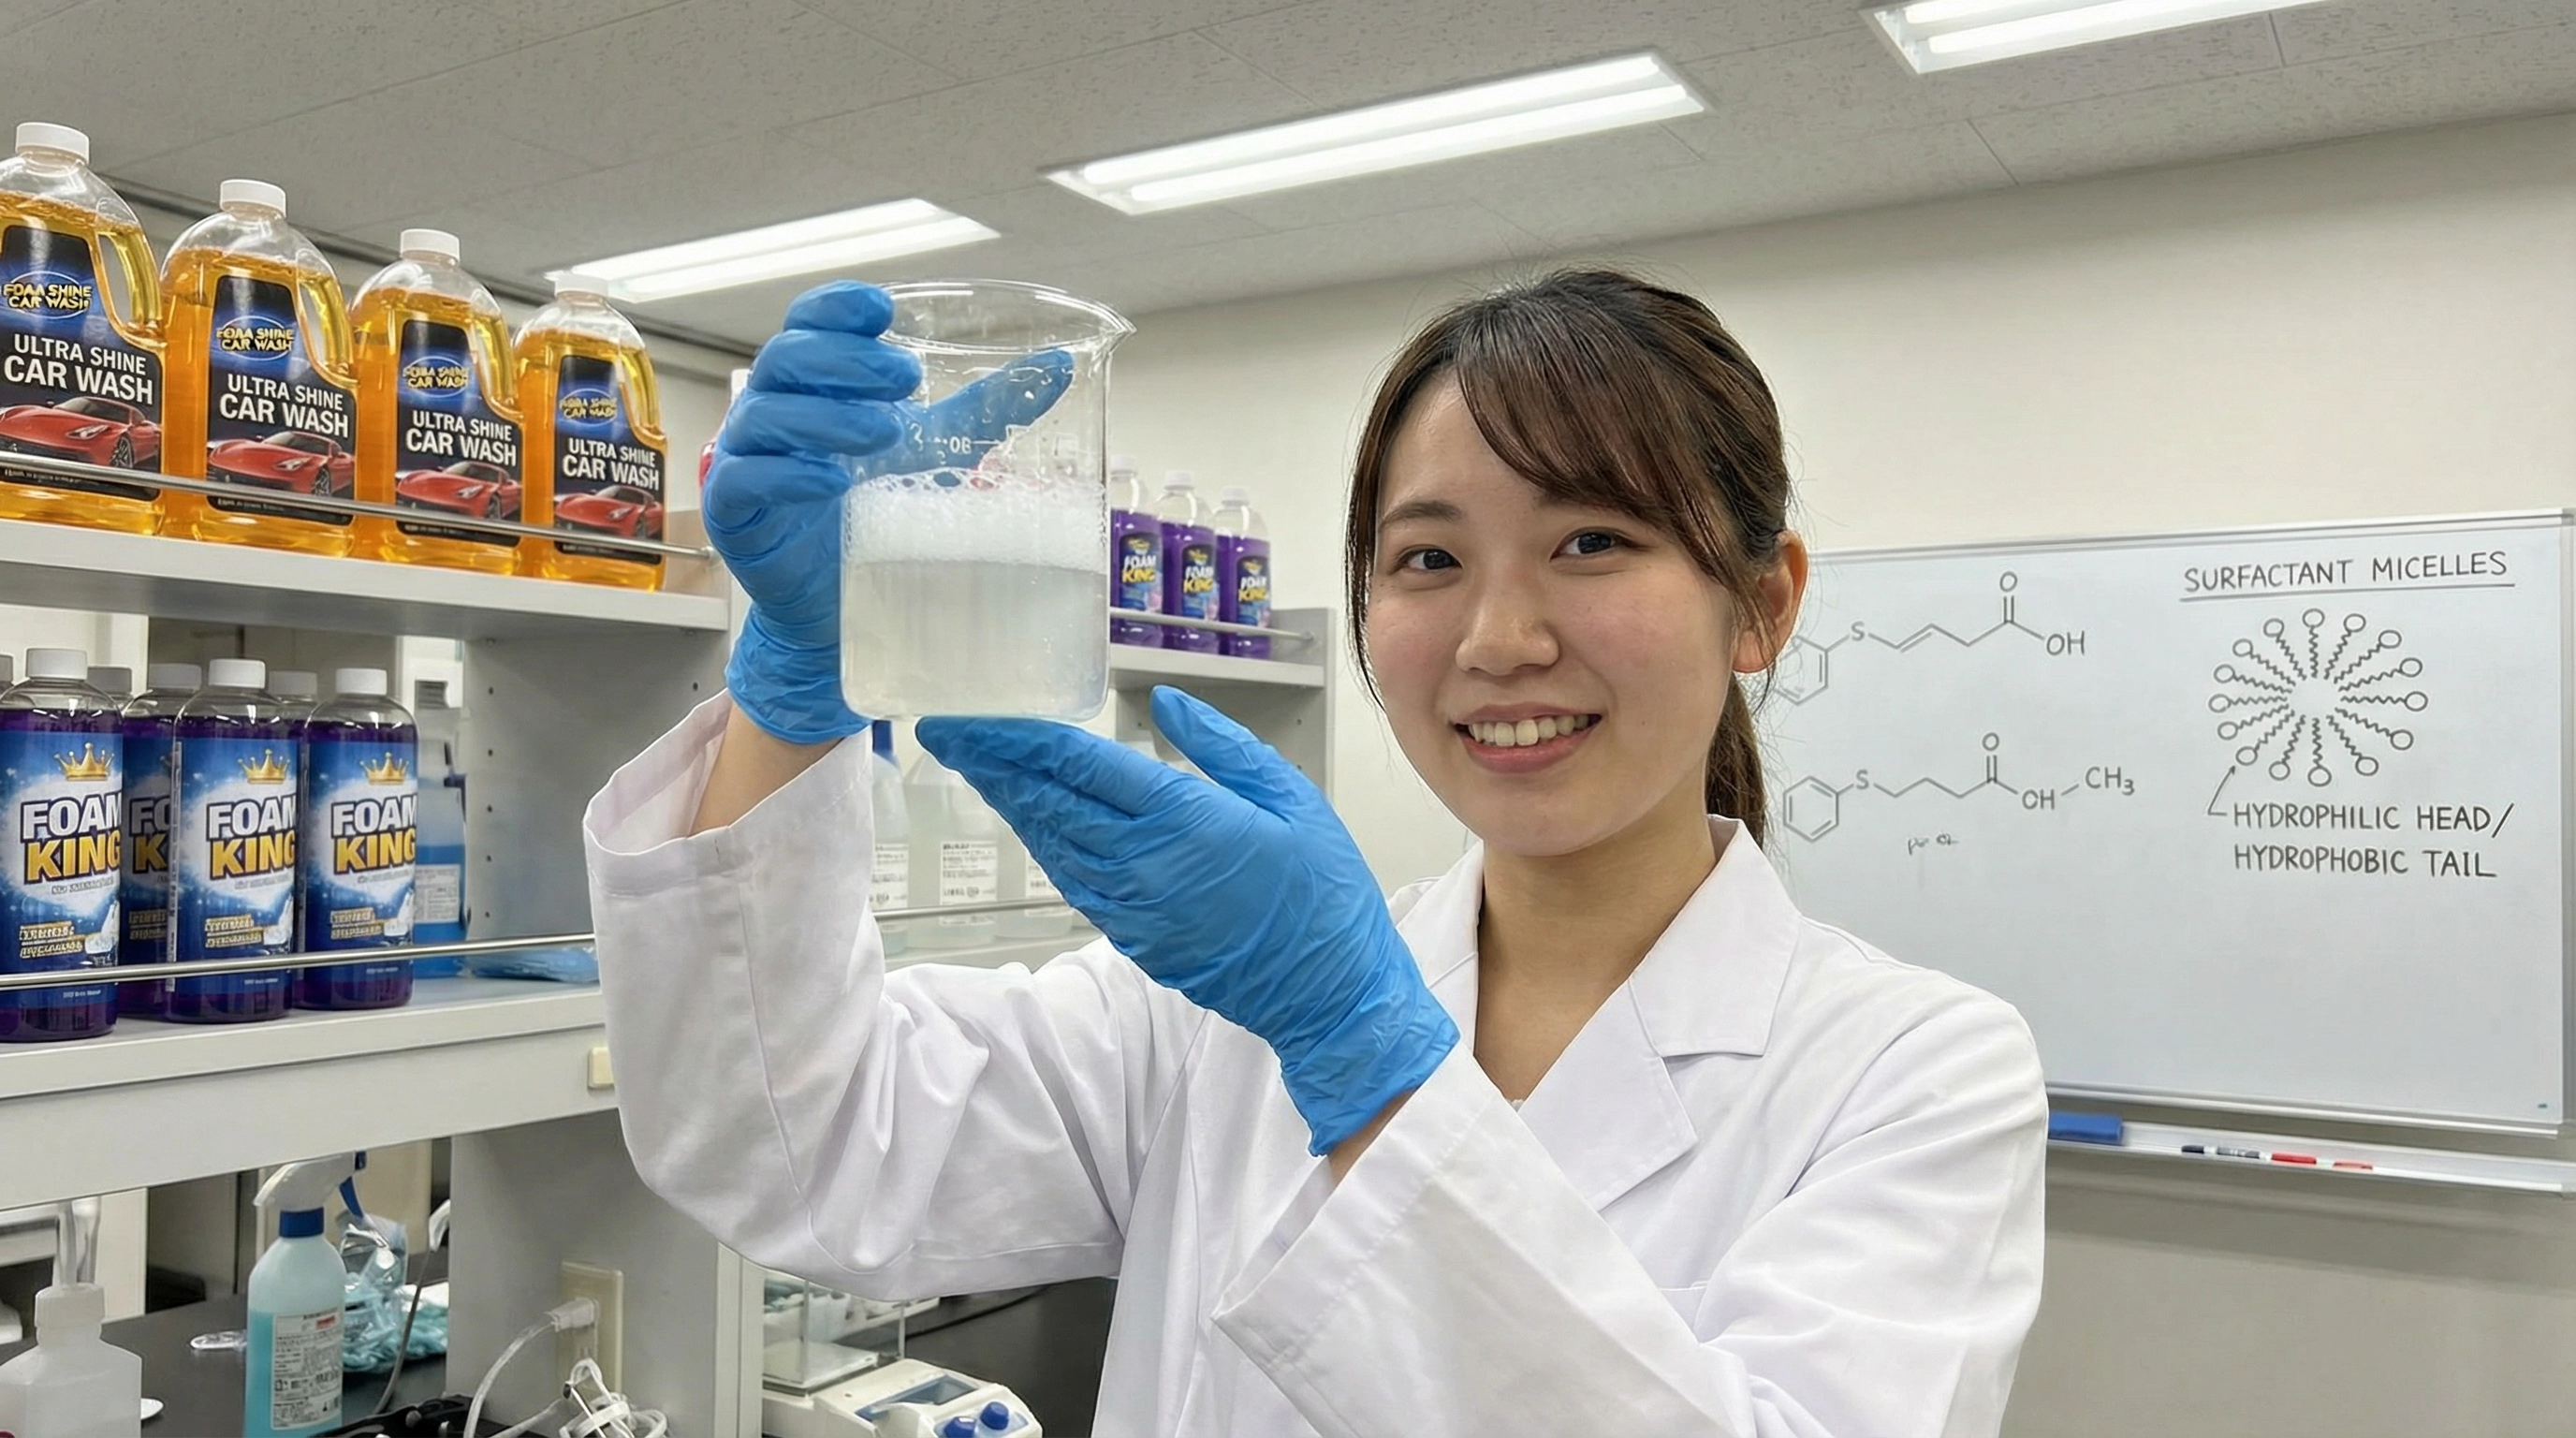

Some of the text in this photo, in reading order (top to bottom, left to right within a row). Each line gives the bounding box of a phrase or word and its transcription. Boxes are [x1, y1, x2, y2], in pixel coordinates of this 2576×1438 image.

[8, 296, 44, 309] CAR
[14, 333, 147, 375] ULTRA SHINE
[221, 339, 292, 351] CAR WASH
[4, 355, 154, 405] CAR WASH
[227, 374, 344, 411] ULTRA SHINE
[219, 393, 348, 438] CAR WASH
[413, 409, 512, 442] ULTRA SHINE
[406, 428, 517, 467] CAR WASH
[568, 437, 656, 468] ULTRA SHINE
[563, 454, 660, 491] CAR WASH
[2183, 550, 2509, 593] SURFACTANT MICELLES
[2045, 629, 2086, 656] OH
[21, 791, 123, 843] FOAM
[206, 793, 297, 842] FOAM
[330, 792, 417, 839] FOAM
[2021, 789, 2056, 811] OH
[2233, 802, 2515, 838] HYDROPHILIC HEAD/
[24, 829, 122, 885] KING
[210, 829, 296, 880] KING
[334, 828, 416, 875] KING
[2233, 844, 2497, 878] HYDROPHOBIC TAIL
